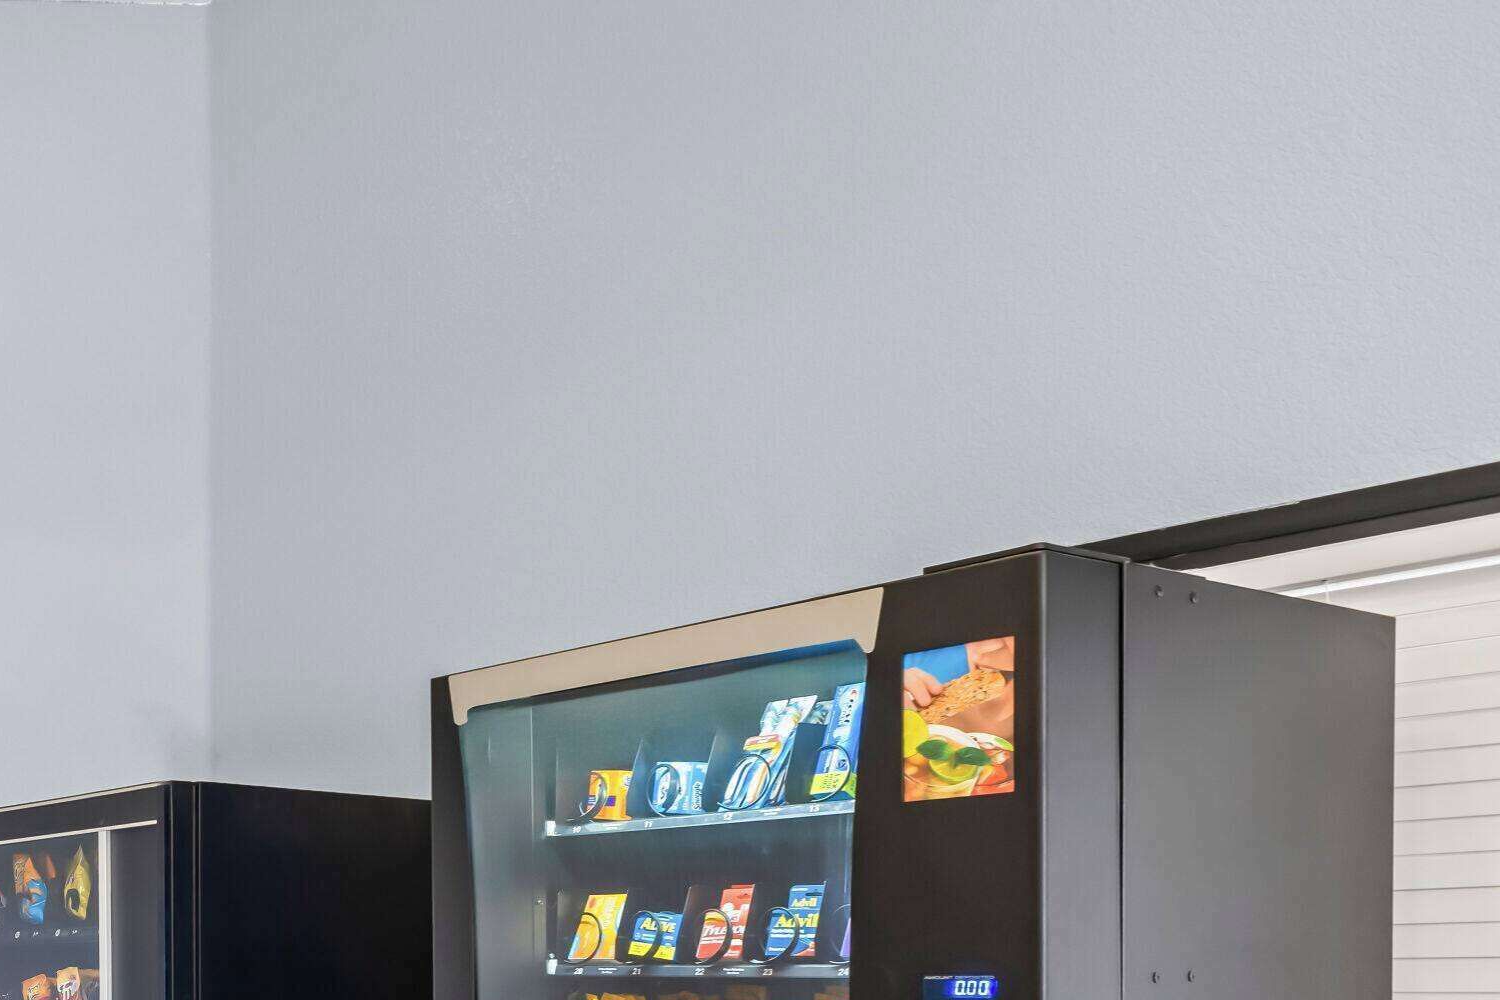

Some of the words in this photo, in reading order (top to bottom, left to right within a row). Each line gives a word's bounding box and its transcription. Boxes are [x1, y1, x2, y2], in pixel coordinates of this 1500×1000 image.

[632, 968, 642, 976] 21
[695, 968, 706, 976] 22
[762, 968, 773, 977] 23
[838, 967, 850, 976] 24
